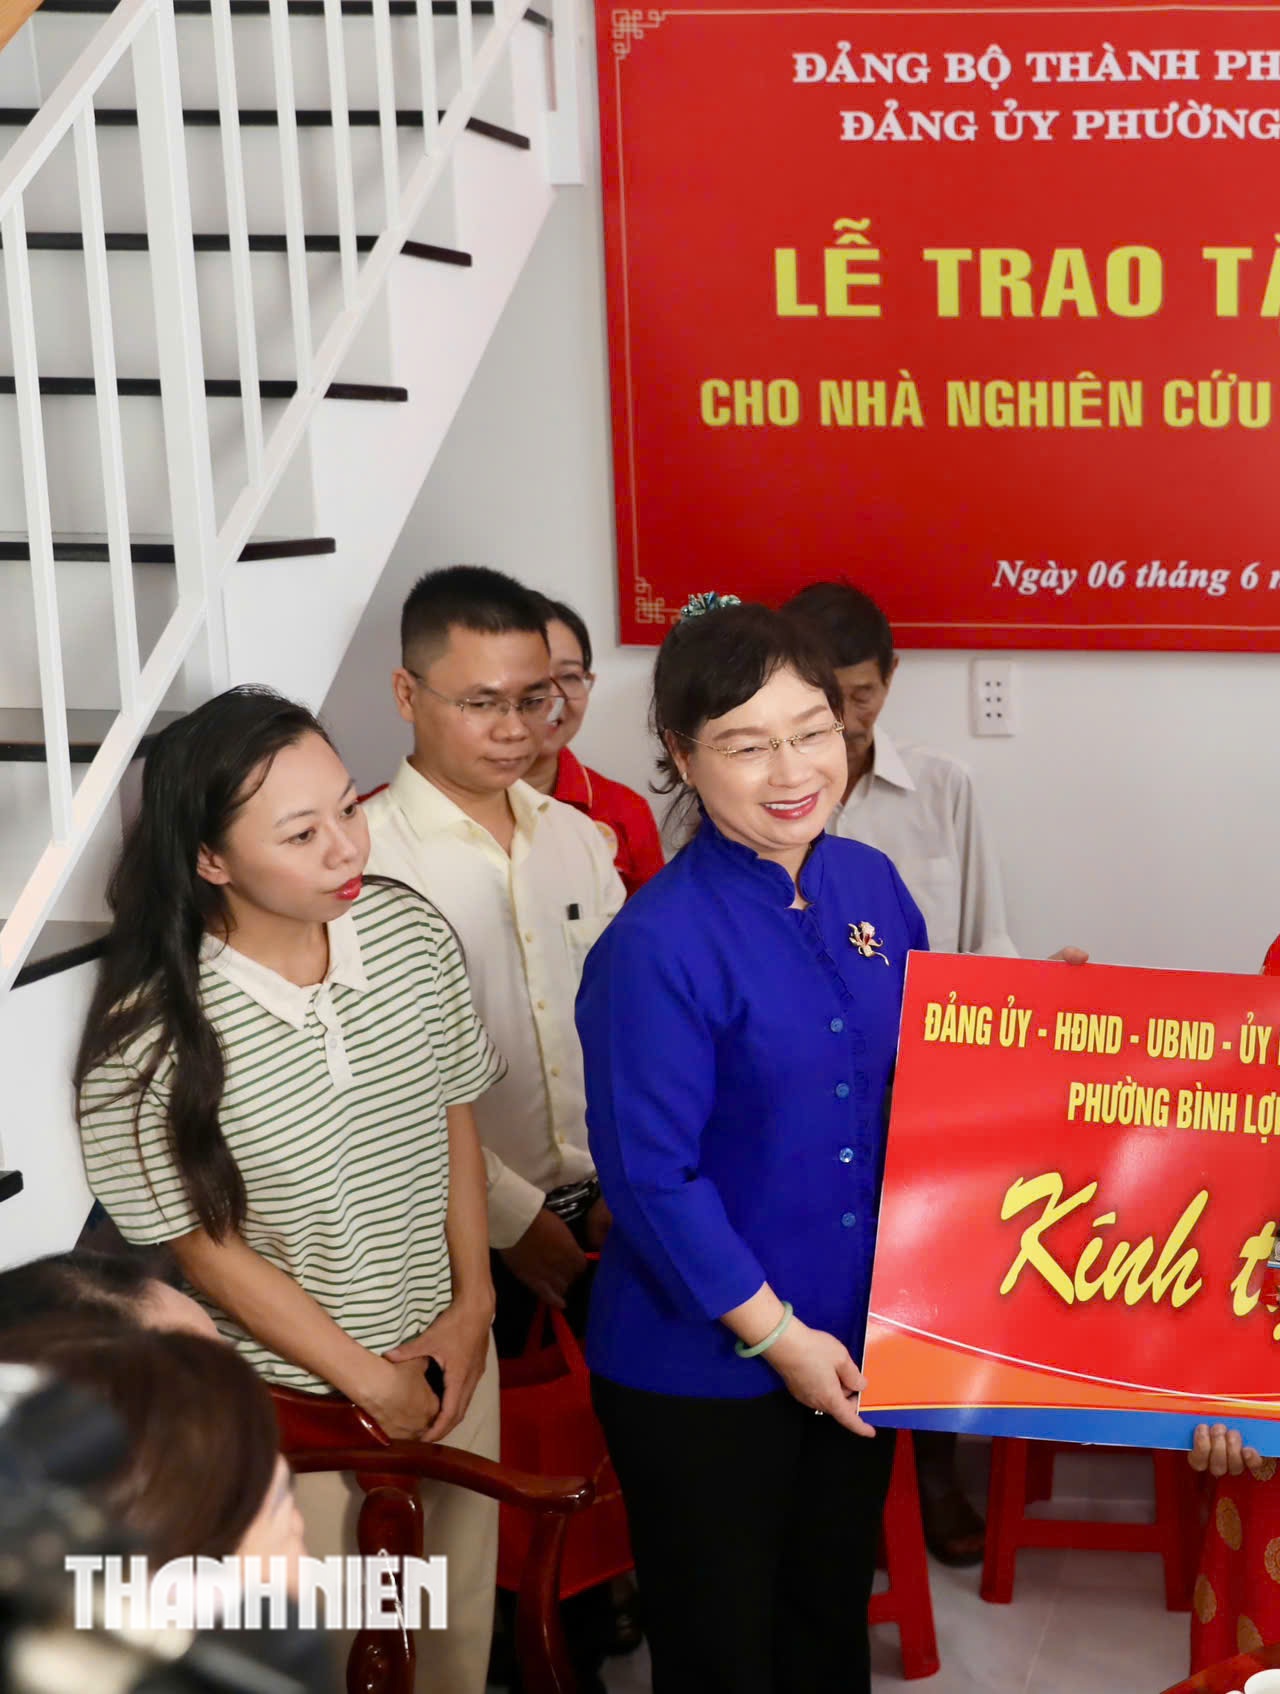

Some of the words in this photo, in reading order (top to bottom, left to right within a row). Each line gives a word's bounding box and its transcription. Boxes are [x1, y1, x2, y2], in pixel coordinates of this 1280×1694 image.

[792, 41, 931, 83] ĐẢNG
[943, 44, 1012, 89] BỘ
[1025, 42, 1200, 82] THÀNH
[840, 99, 979, 141] ĐẢNG
[991, 98, 1060, 141] ỦY
[775, 216, 881, 317] LỄ
[923, 245, 1163, 318] TRAO
[701, 379, 799, 426] CHO
[820, 369, 924, 427] NHÀ
[947, 371, 1143, 428] NGHIÊN
[1163, 369, 1271, 429] CỨU
[993, 560, 1078, 595] Ngày
[1088, 561, 1126, 588] 06
[1135, 560, 1230, 596] tháng
[1240, 562, 1259, 590] 6
[924, 991, 993, 1045] ĐẢNG
[999, 995, 1032, 1048] ỦY
[1054, 1012, 1123, 1055] HĐND
[1147, 1018, 1215, 1061] UBND
[1239, 1010, 1272, 1064] ỦY
[1068, 1076, 1170, 1128] PHƯỜNG
[1176, 1082, 1238, 1132] BÌNH
[1243, 1090, 1280, 1143] LỢI
[1000, 1173, 1209, 1308] Kính
